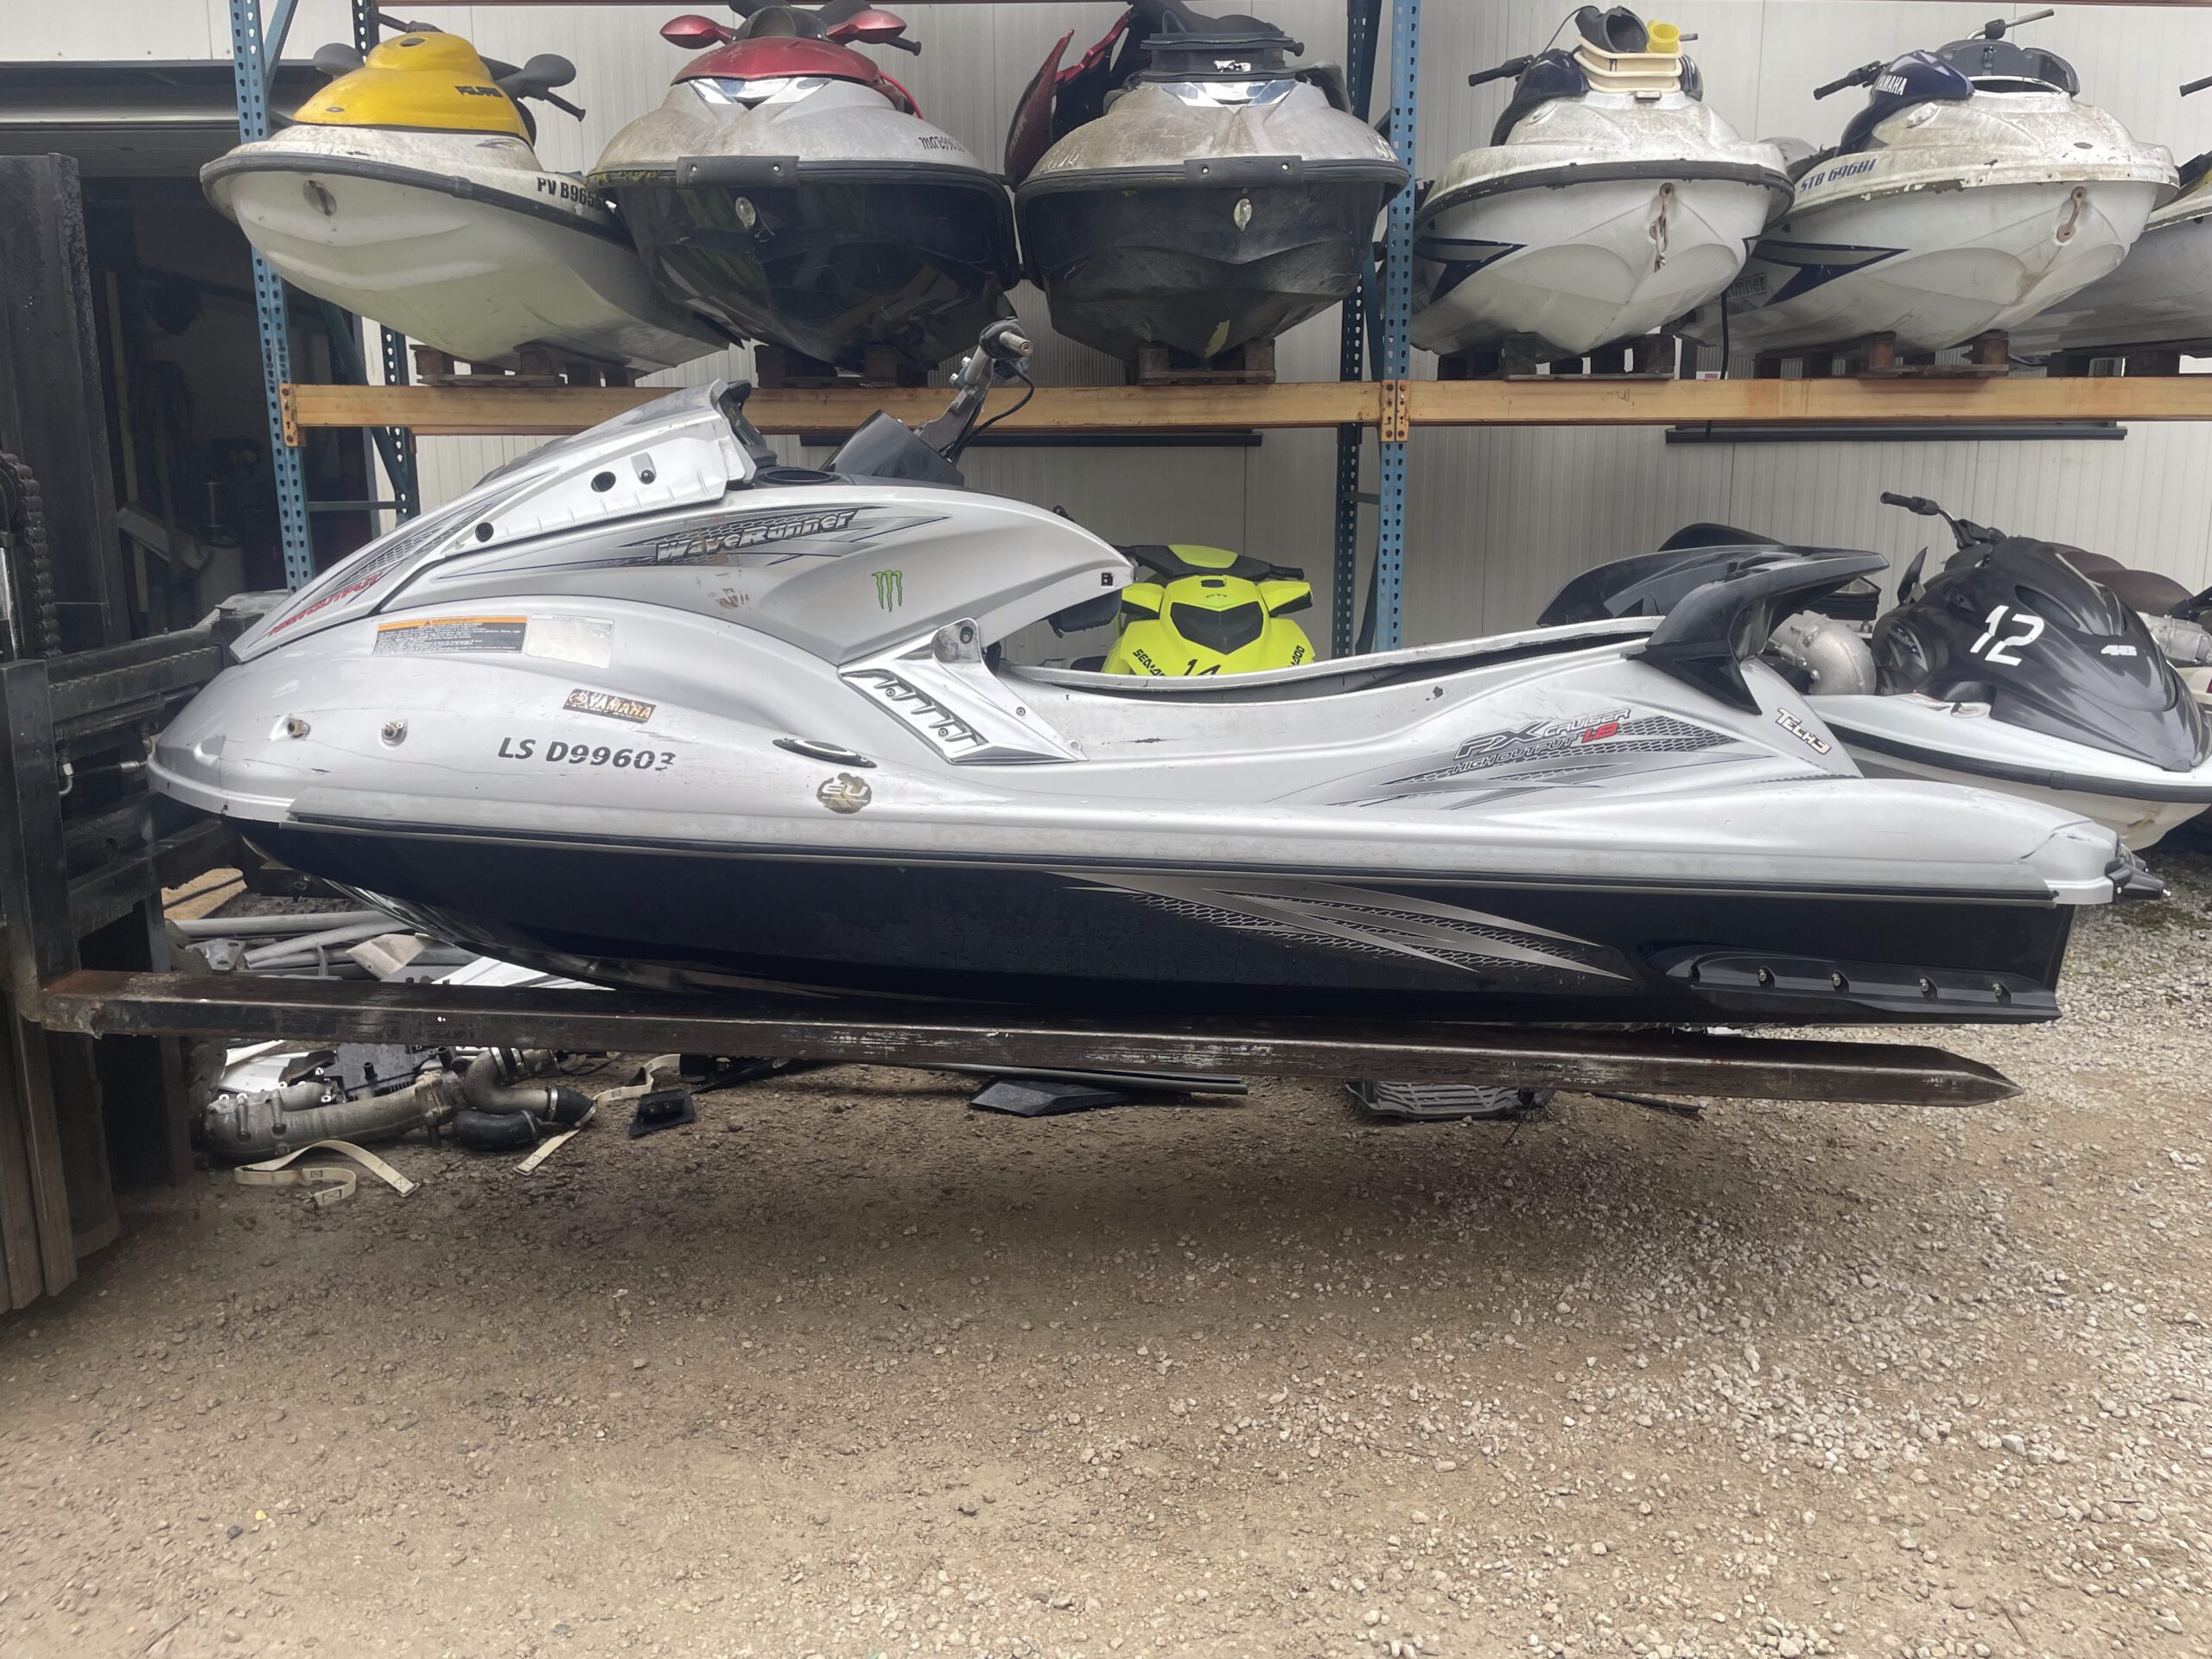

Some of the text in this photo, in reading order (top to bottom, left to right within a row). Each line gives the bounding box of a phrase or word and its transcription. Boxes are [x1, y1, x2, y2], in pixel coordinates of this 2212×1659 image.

[537, 177, 604, 210] PV B9655
[1970, 605, 2044, 666] 12
[588, 692, 652, 718] YAMAHA
[1453, 708, 1631, 761] FX CRUISER
[498, 737, 677, 771] LS D99603
[1452, 754, 1497, 774] HIGH
[1497, 735, 1578, 763] OUTPUT
